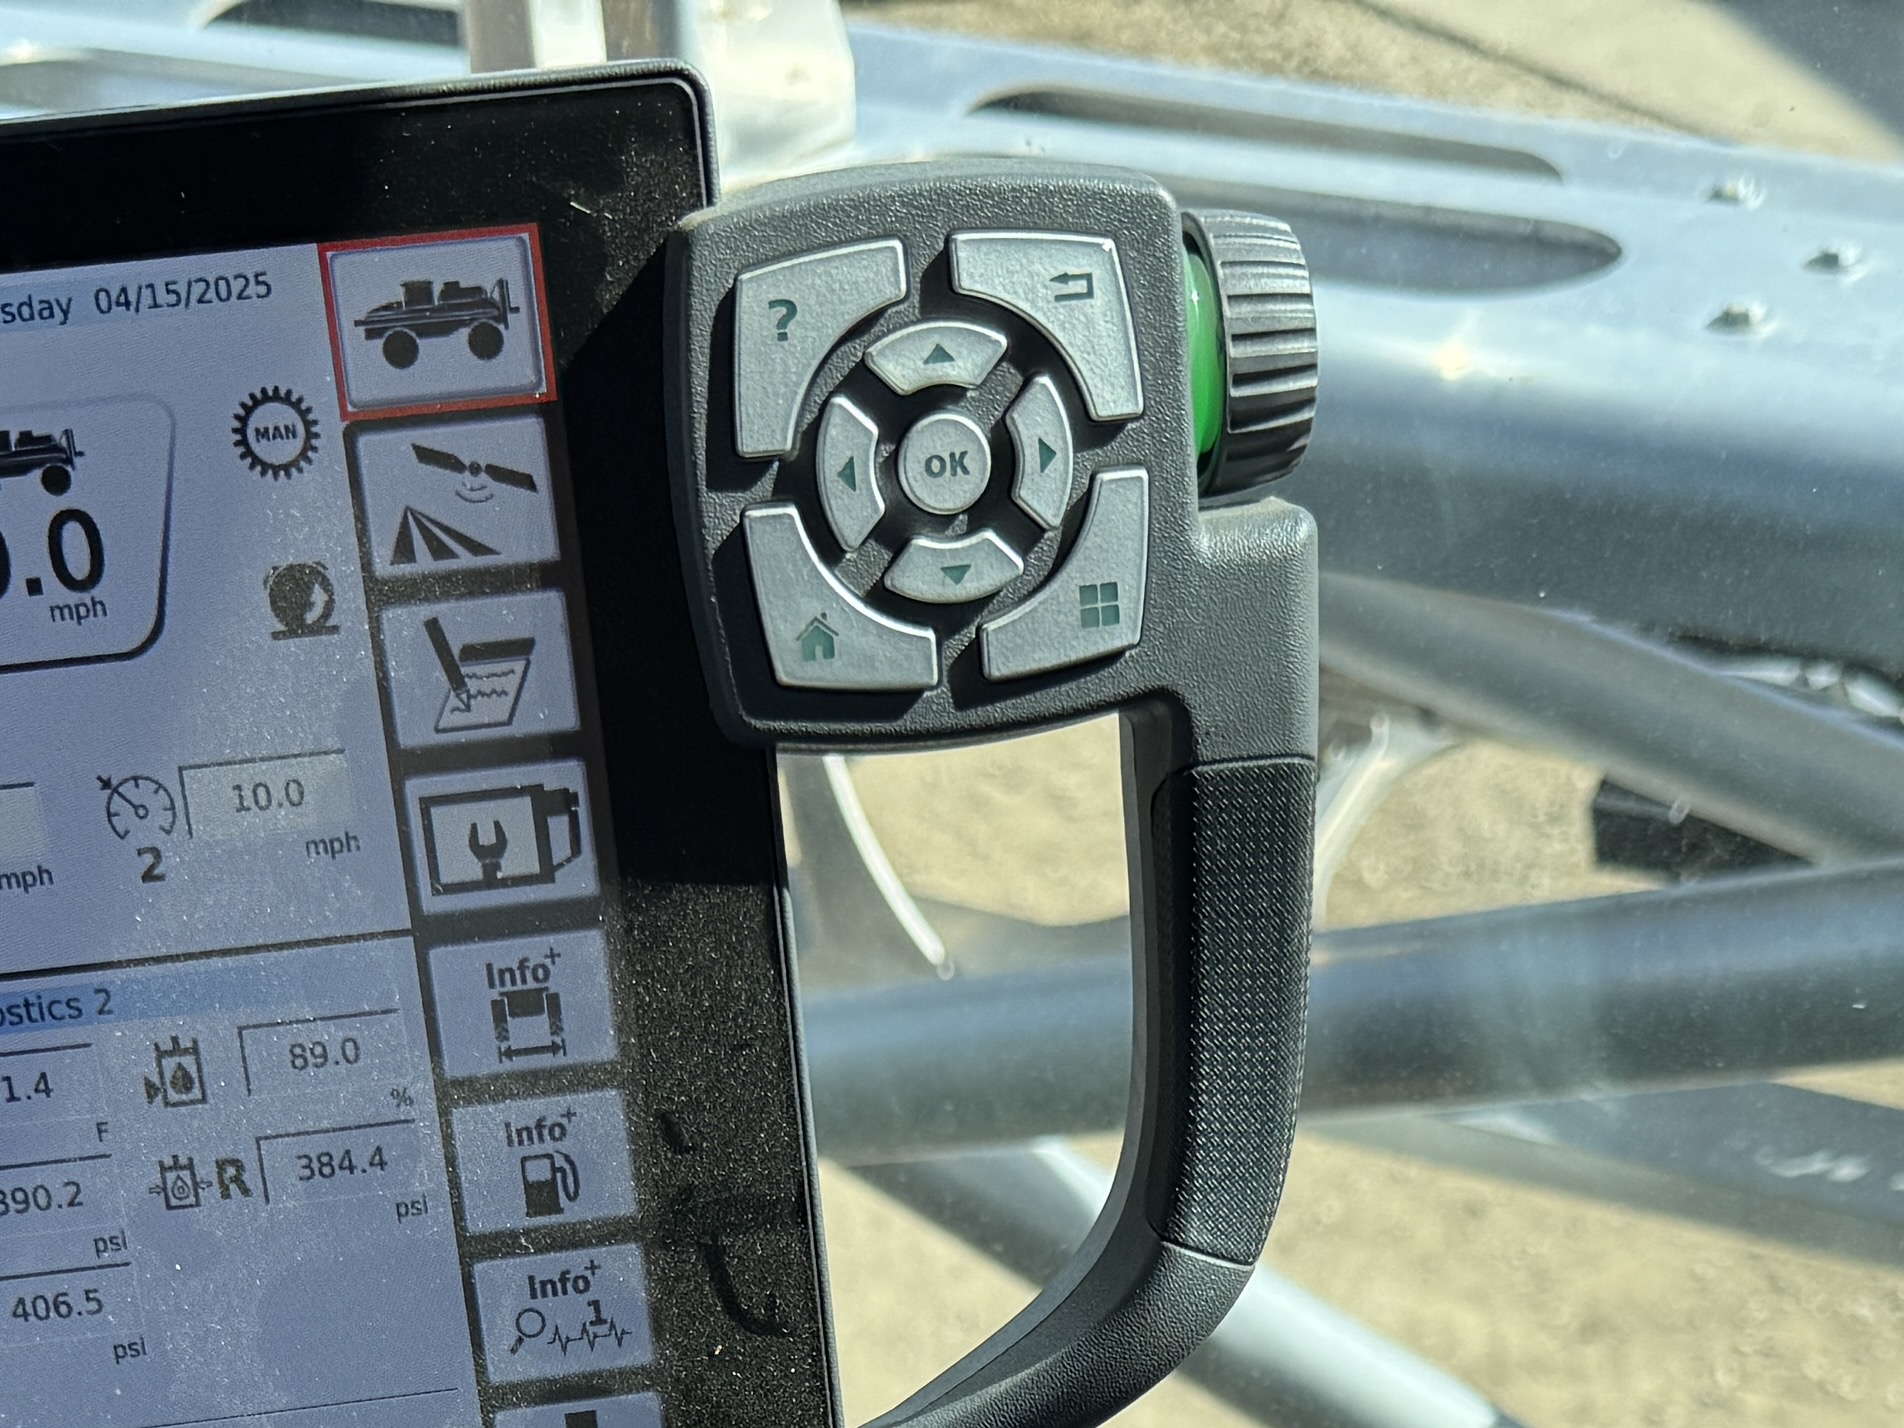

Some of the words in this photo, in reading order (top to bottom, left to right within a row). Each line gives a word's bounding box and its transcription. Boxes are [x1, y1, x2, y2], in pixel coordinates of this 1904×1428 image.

[93, 270, 272, 316] 04/15/2025
[253, 421, 298, 444] MAN
[923, 450, 970, 479] OK
[49, 596, 108, 627] mph
[233, 778, 306, 815] 10.0
[305, 831, 362, 861] mph
[136, 845, 167, 885] 2
[93, 988, 114, 1017] 2
[96, 1121, 110, 1144] F
[214, 1157, 255, 1201] R
[296, 1144, 390, 1183] 384.4
[395, 1196, 430, 1225] psi
[92, 1229, 130, 1260] psi
[11, 1287, 106, 1324] 406.5
[112, 1336, 149, 1365] psi
